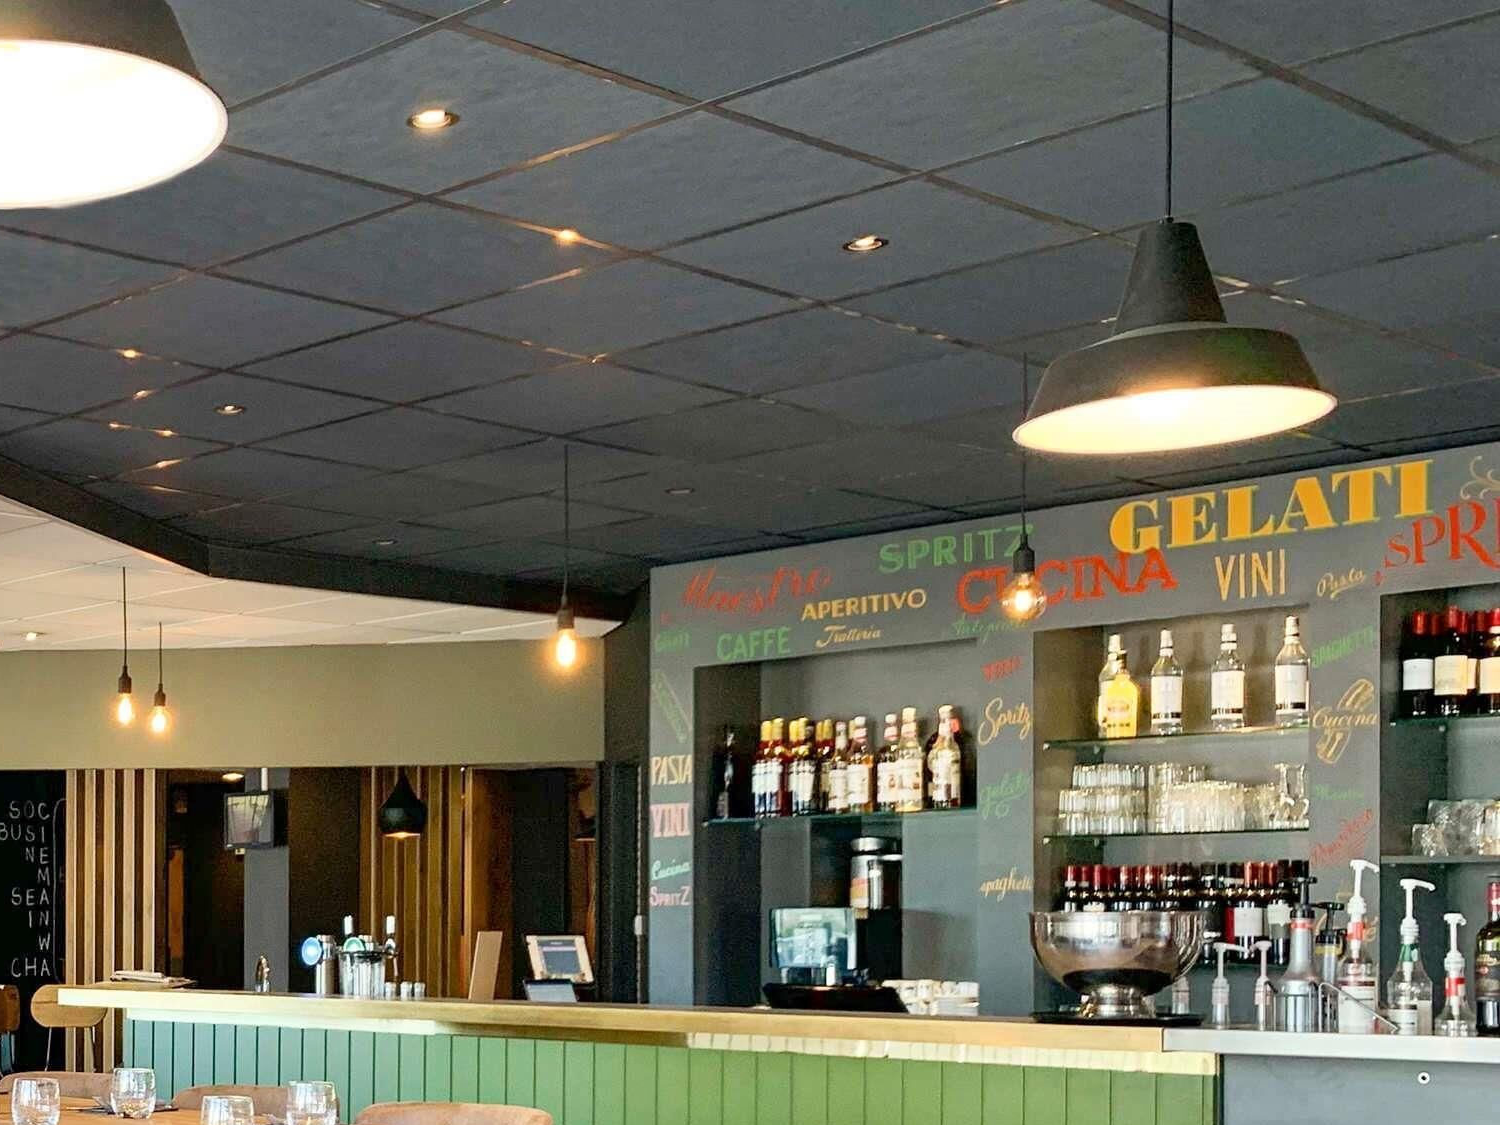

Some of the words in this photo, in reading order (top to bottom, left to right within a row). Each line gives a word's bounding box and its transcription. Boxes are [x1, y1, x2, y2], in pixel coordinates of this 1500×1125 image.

[1109, 459, 1434, 554] GELATI
[879, 524, 1033, 573] SPRITZ
[1214, 548, 1288, 601] VINI
[1317, 567, 1366, 598] Pasta
[801, 588, 927, 621] APERITIVO
[815, 624, 883, 648] Trattoria
[978, 697, 1032, 746] Spritz
[651, 754, 692, 786] PASTA
[9, 801, 50, 820] SOC
[650, 803, 691, 837] VINI
[25, 847, 49, 865] NE
[11, 887, 50, 906] SEA
[28, 910, 49, 928] IN
[11, 957, 50, 978] CHA
